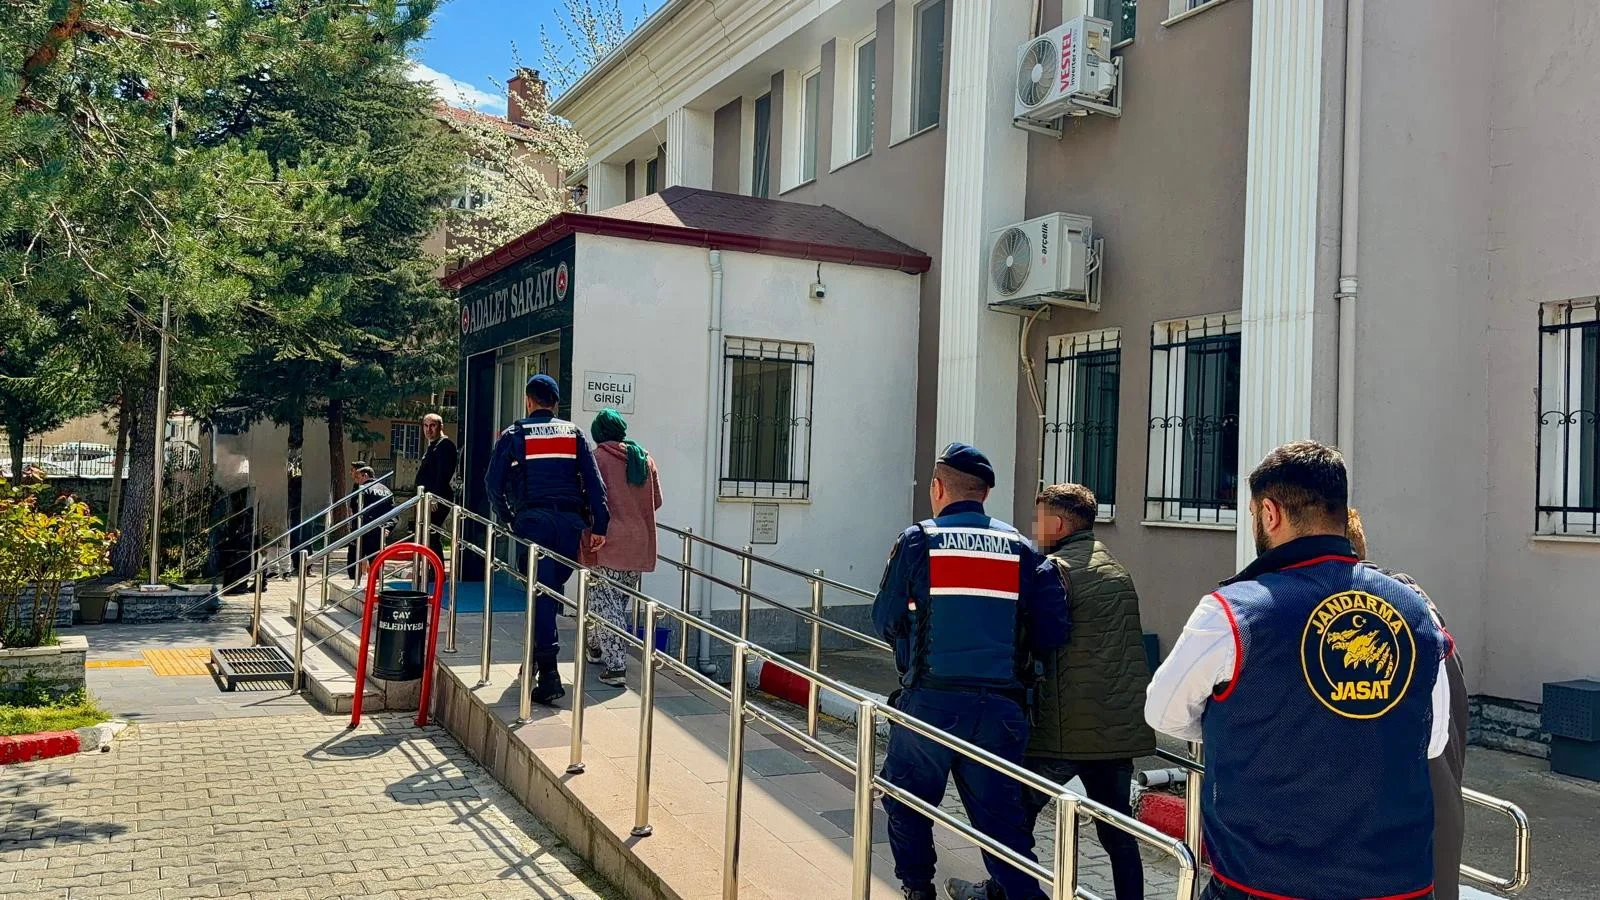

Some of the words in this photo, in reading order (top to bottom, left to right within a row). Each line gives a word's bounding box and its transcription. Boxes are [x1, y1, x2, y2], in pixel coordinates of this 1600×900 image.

[1060, 28, 1072, 93] VESTEL
[469, 288, 509, 334] ADALET
[510, 267, 556, 319] SARAYI
[588, 381, 632, 393] ENGELLİ
[594, 392, 625, 405] GİRİŞİ
[530, 425, 571, 435] JANDARMA
[939, 532, 1012, 555] JANDARMA
[392, 610, 411, 620] ÇAY
[1312, 595, 1405, 635] JANDARMA
[1330, 680, 1392, 701] JASAT
